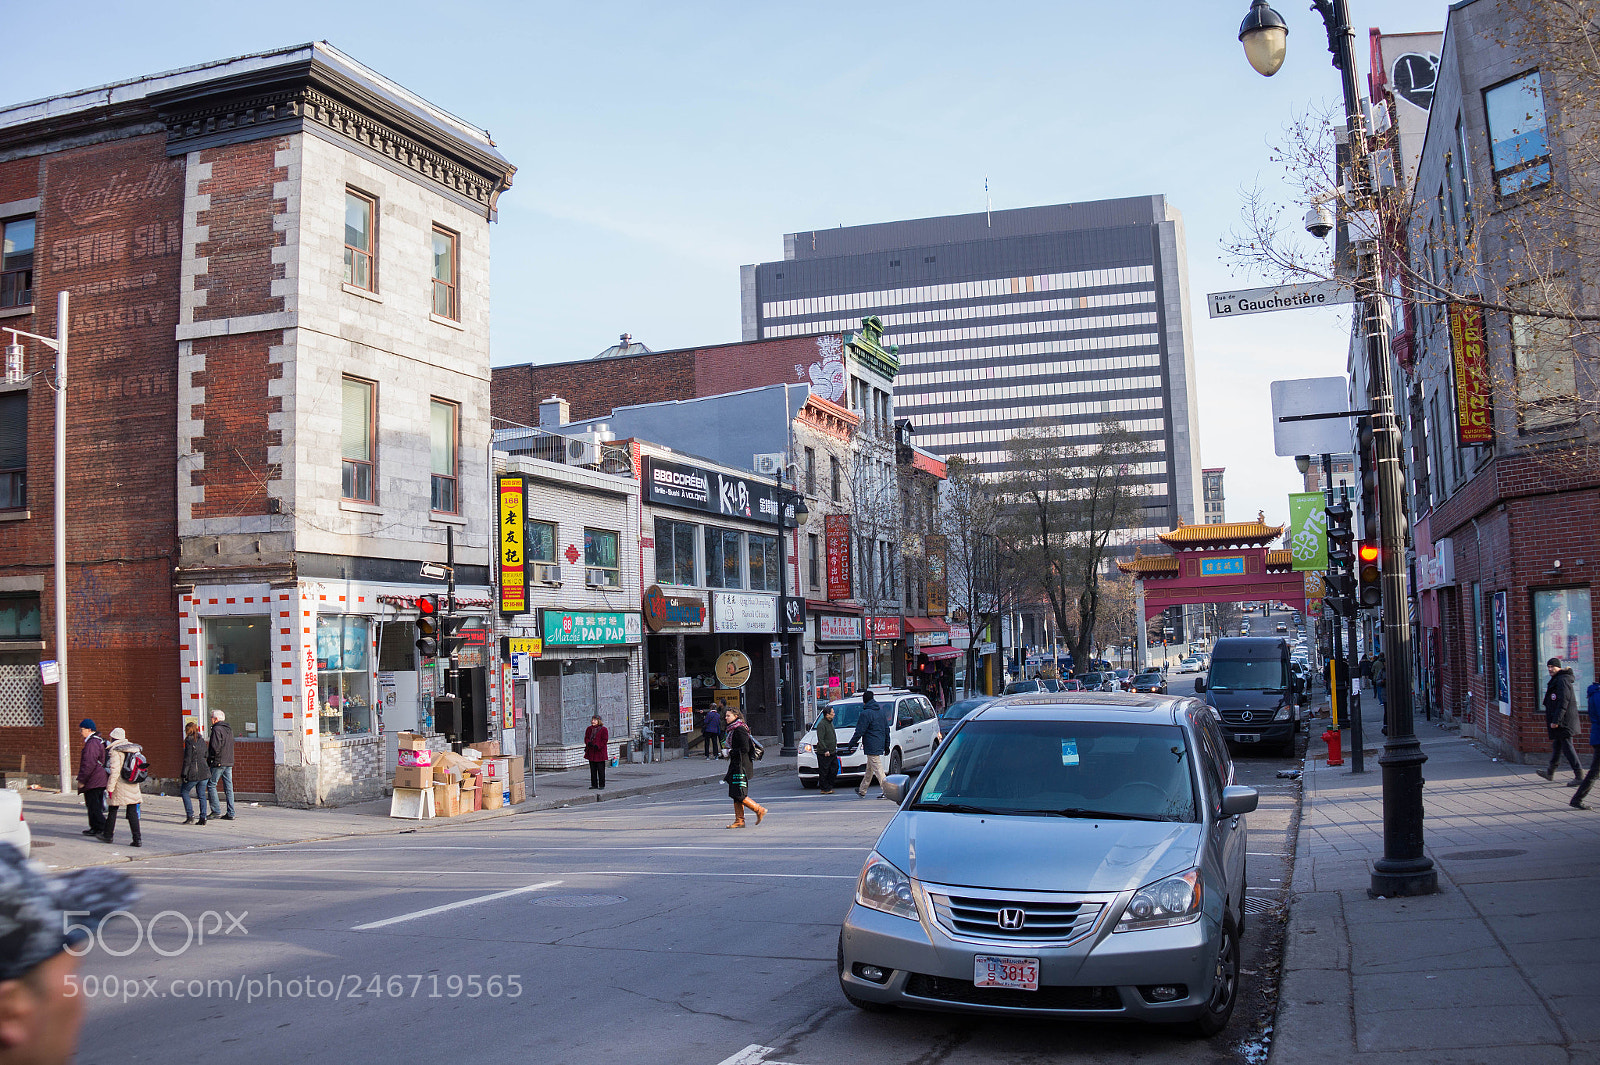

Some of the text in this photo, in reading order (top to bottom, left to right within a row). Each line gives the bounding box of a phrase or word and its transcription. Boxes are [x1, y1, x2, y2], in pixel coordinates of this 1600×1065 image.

[133, 220, 180, 259] SILK
[1215, 293, 1325, 314] La Gauchetière
[654, 469, 707, 490] BBQ CORÉEN
[504, 510, 520, 563] 老友記
[546, 626, 624, 643] Marché PAP PAP
[563, 619, 572, 630] 88
[1000, 964, 1035, 983] 3813
